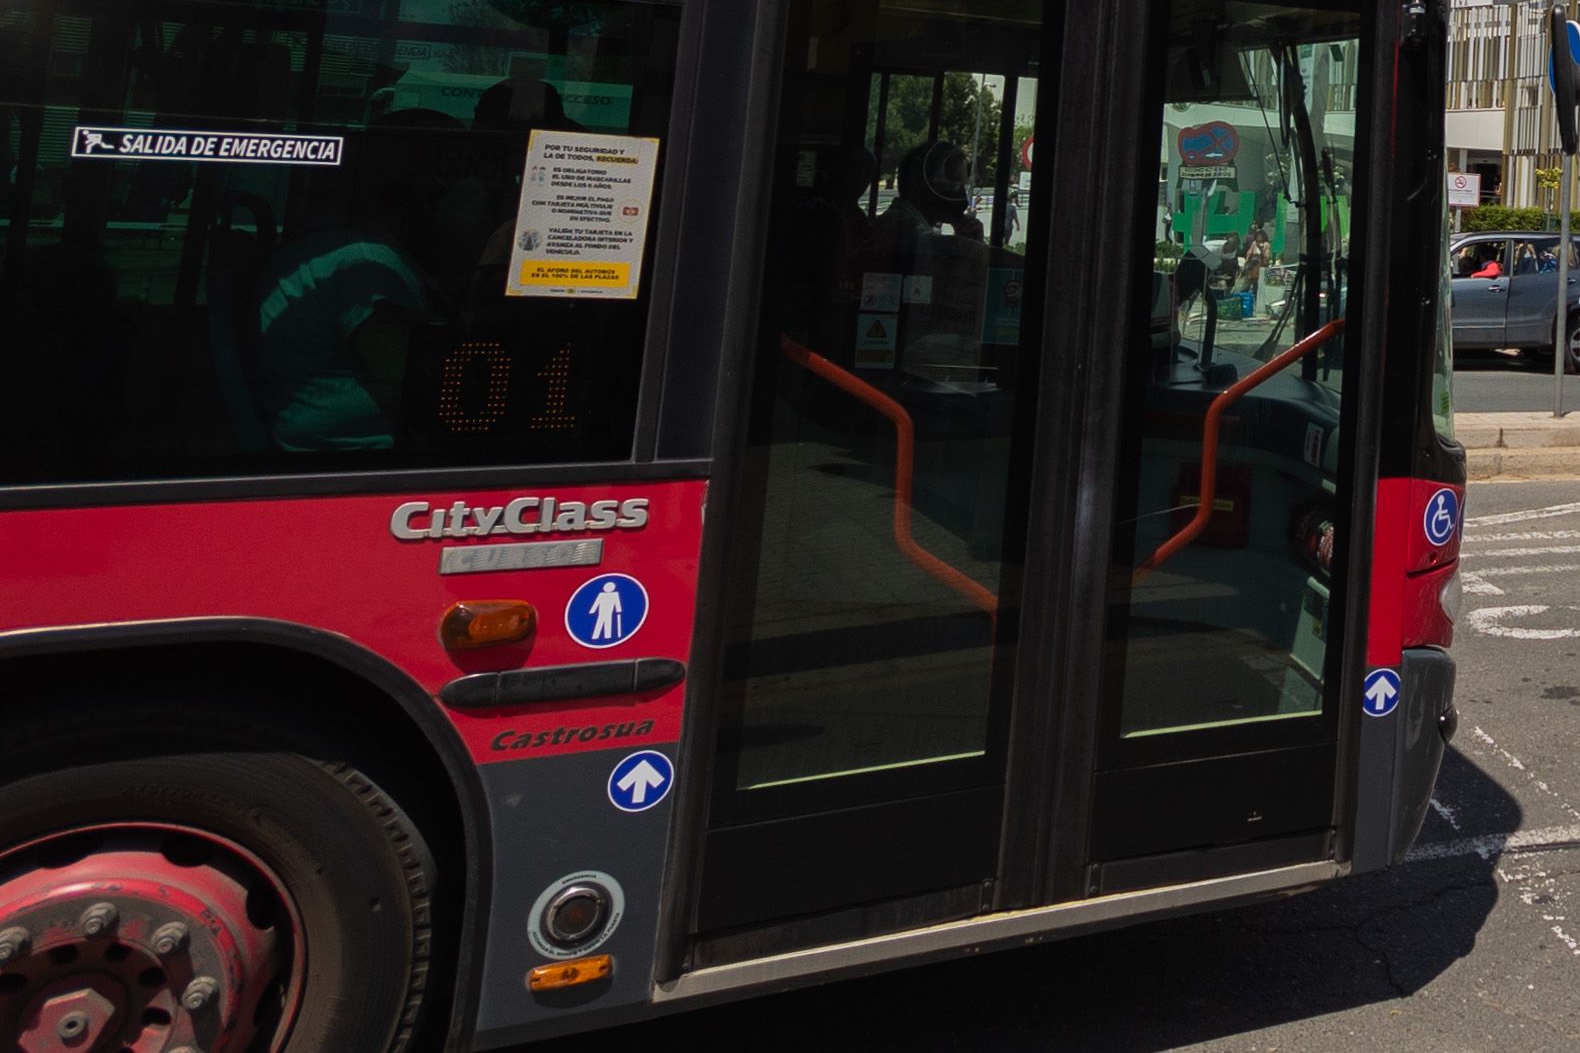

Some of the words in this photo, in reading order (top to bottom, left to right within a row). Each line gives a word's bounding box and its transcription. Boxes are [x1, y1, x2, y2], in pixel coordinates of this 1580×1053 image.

[561, 94, 611, 105] CCESO
[119, 134, 185, 155] SALIDA
[190, 137, 217, 156] DE
[219, 138, 335, 160] EMERGENCIA
[544, 144, 561, 152] POR
[574, 146, 618, 155] SEGURIDAD
[389, 497, 649, 541] CityClass
[491, 719, 656, 752] Castrosua
